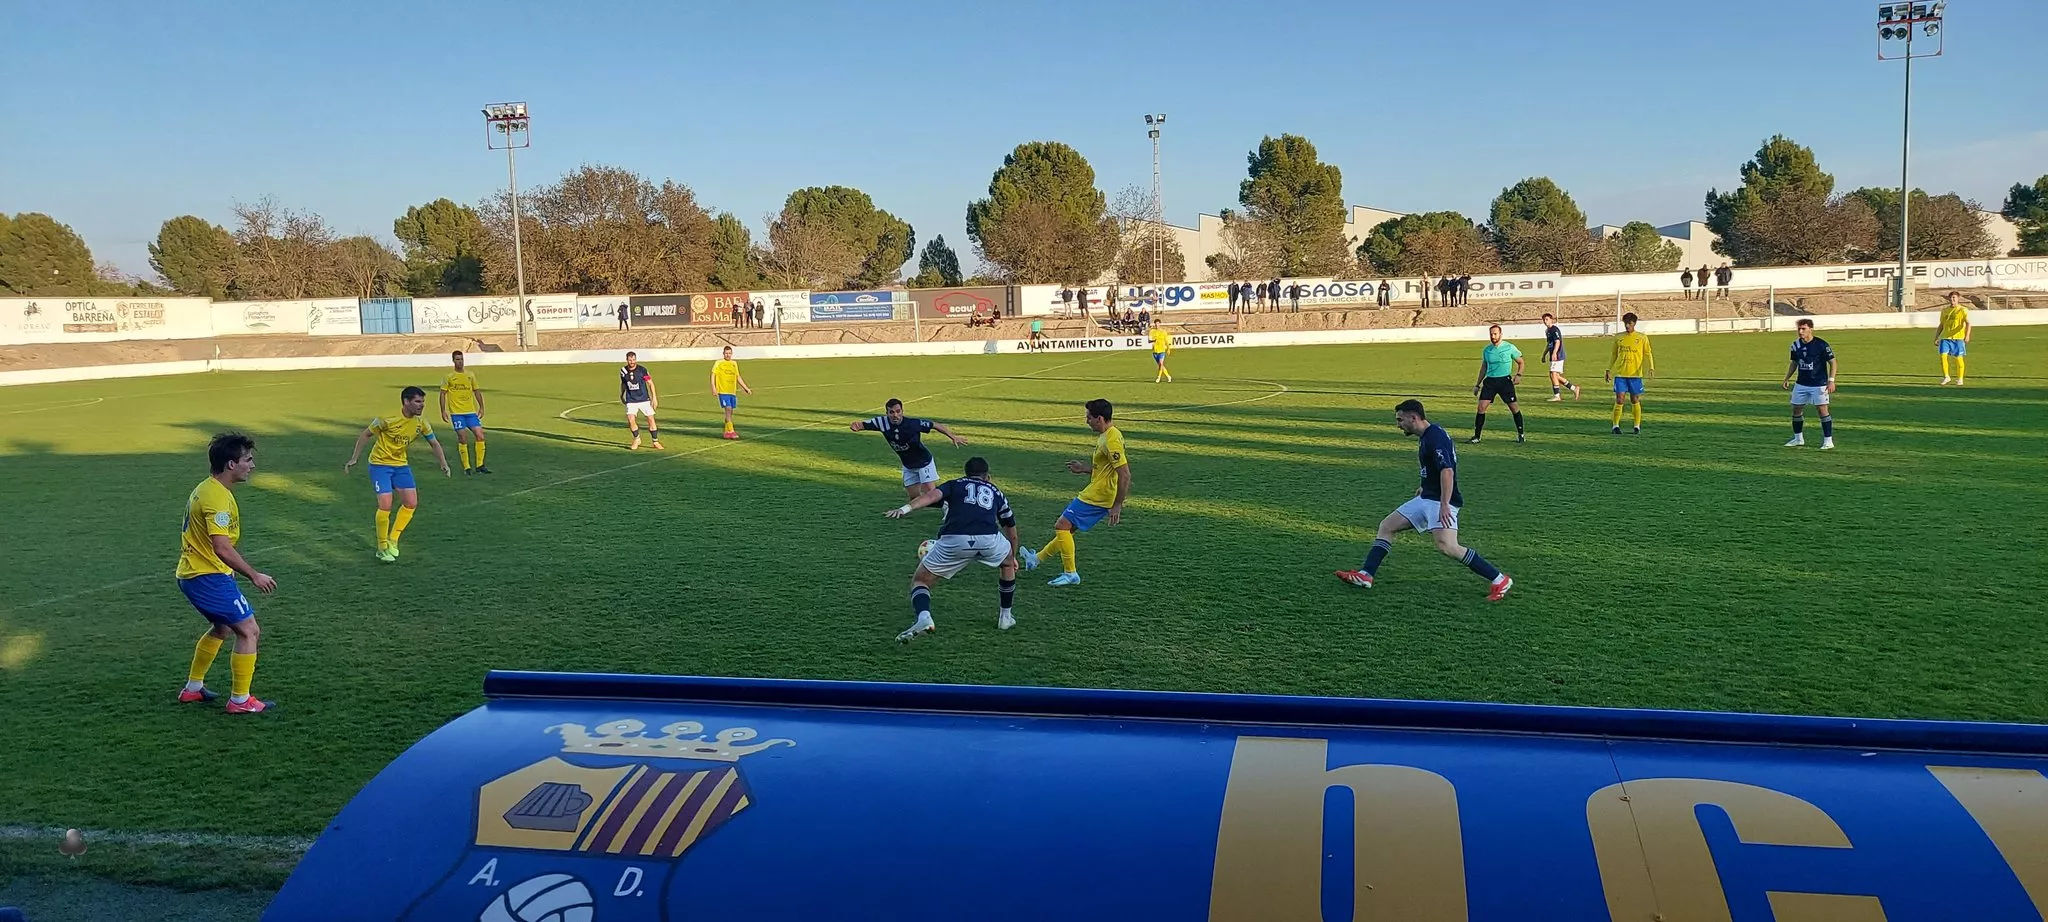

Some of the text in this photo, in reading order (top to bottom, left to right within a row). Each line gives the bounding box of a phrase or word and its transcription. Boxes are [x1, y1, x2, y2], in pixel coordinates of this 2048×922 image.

[1934, 265, 1994, 278] ONNERA
[1129, 285, 1195, 308] yoigo
[536, 307, 573, 315] SOMPORT
[692, 313, 712, 323] Los
[1017, 339, 1114, 350] AYUNTAMIENTO
[1126, 338, 1143, 347] DE
[453, 420, 463, 429] 22
[963, 482, 995, 511] 18
[233, 594, 250, 615] 19
[468, 858, 644, 898] A. D.
